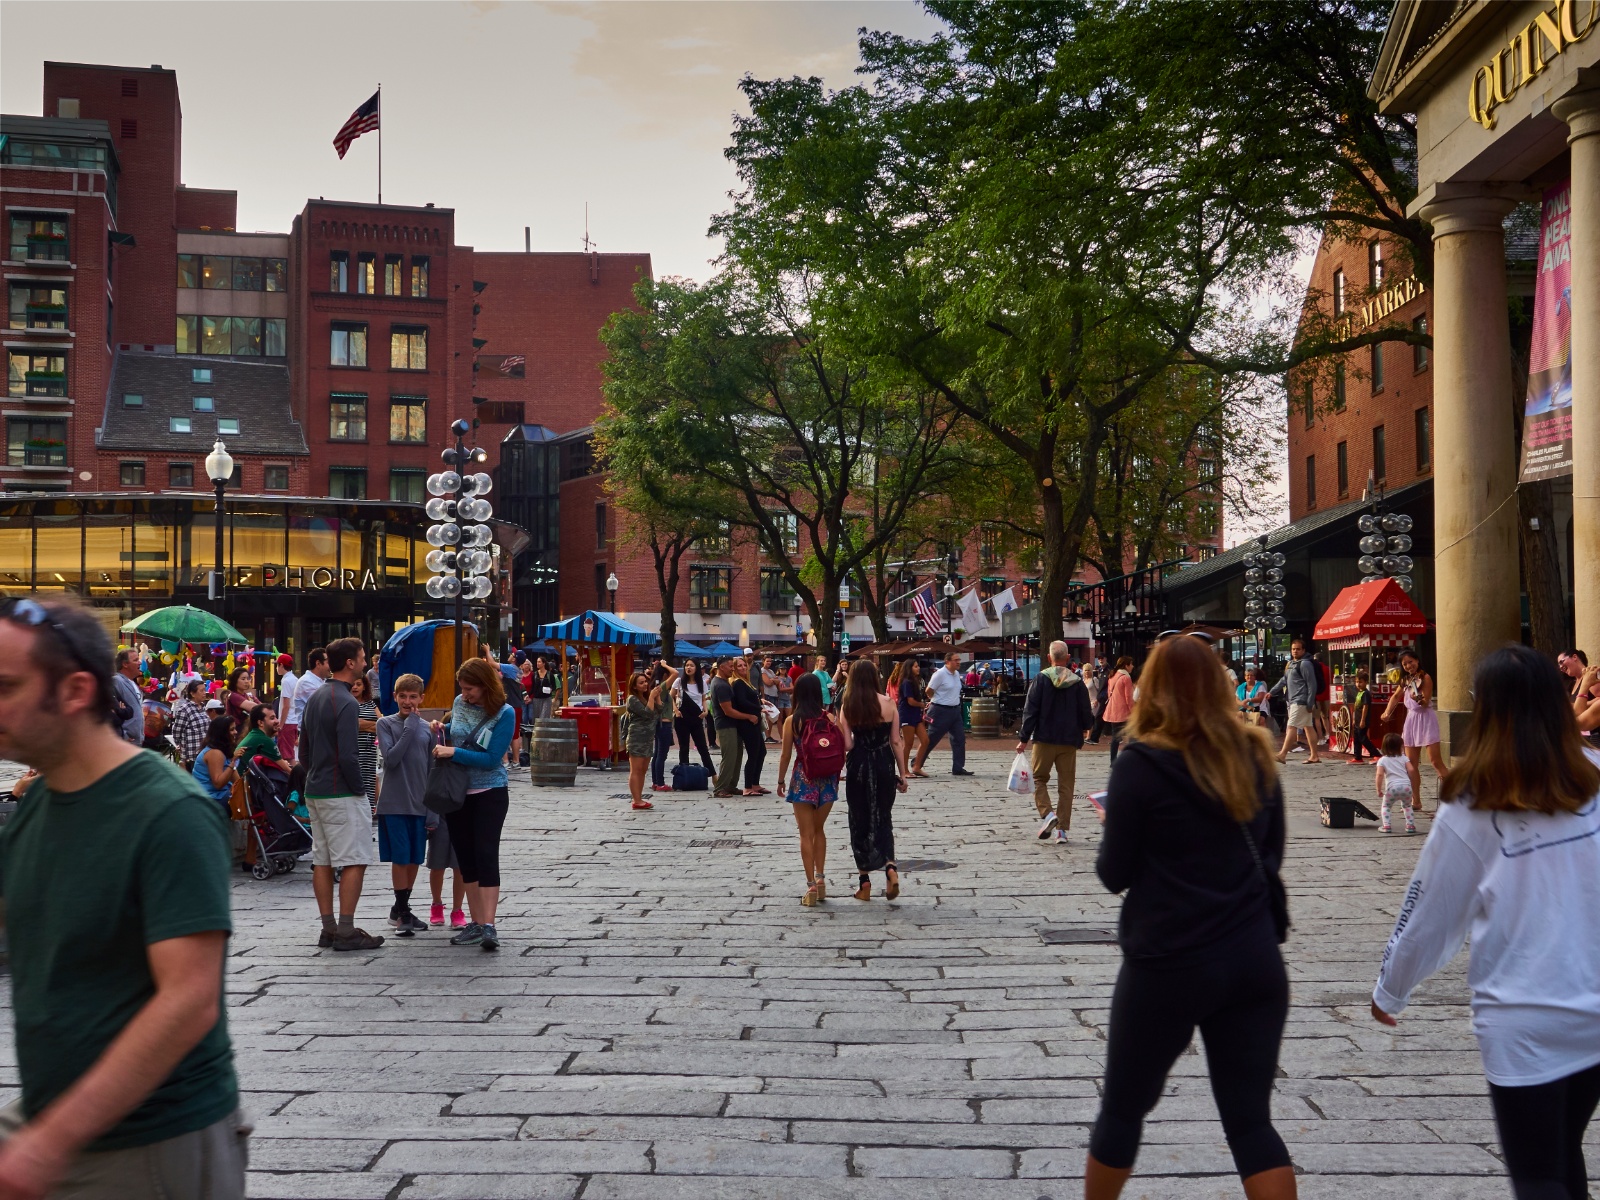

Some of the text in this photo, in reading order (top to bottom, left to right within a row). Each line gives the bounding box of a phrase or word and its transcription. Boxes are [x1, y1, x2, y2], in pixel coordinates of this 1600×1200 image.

[1544, 213, 1571, 249] HEA
[1542, 239, 1571, 274] AWA
[223, 566, 379, 591] EPHORA
